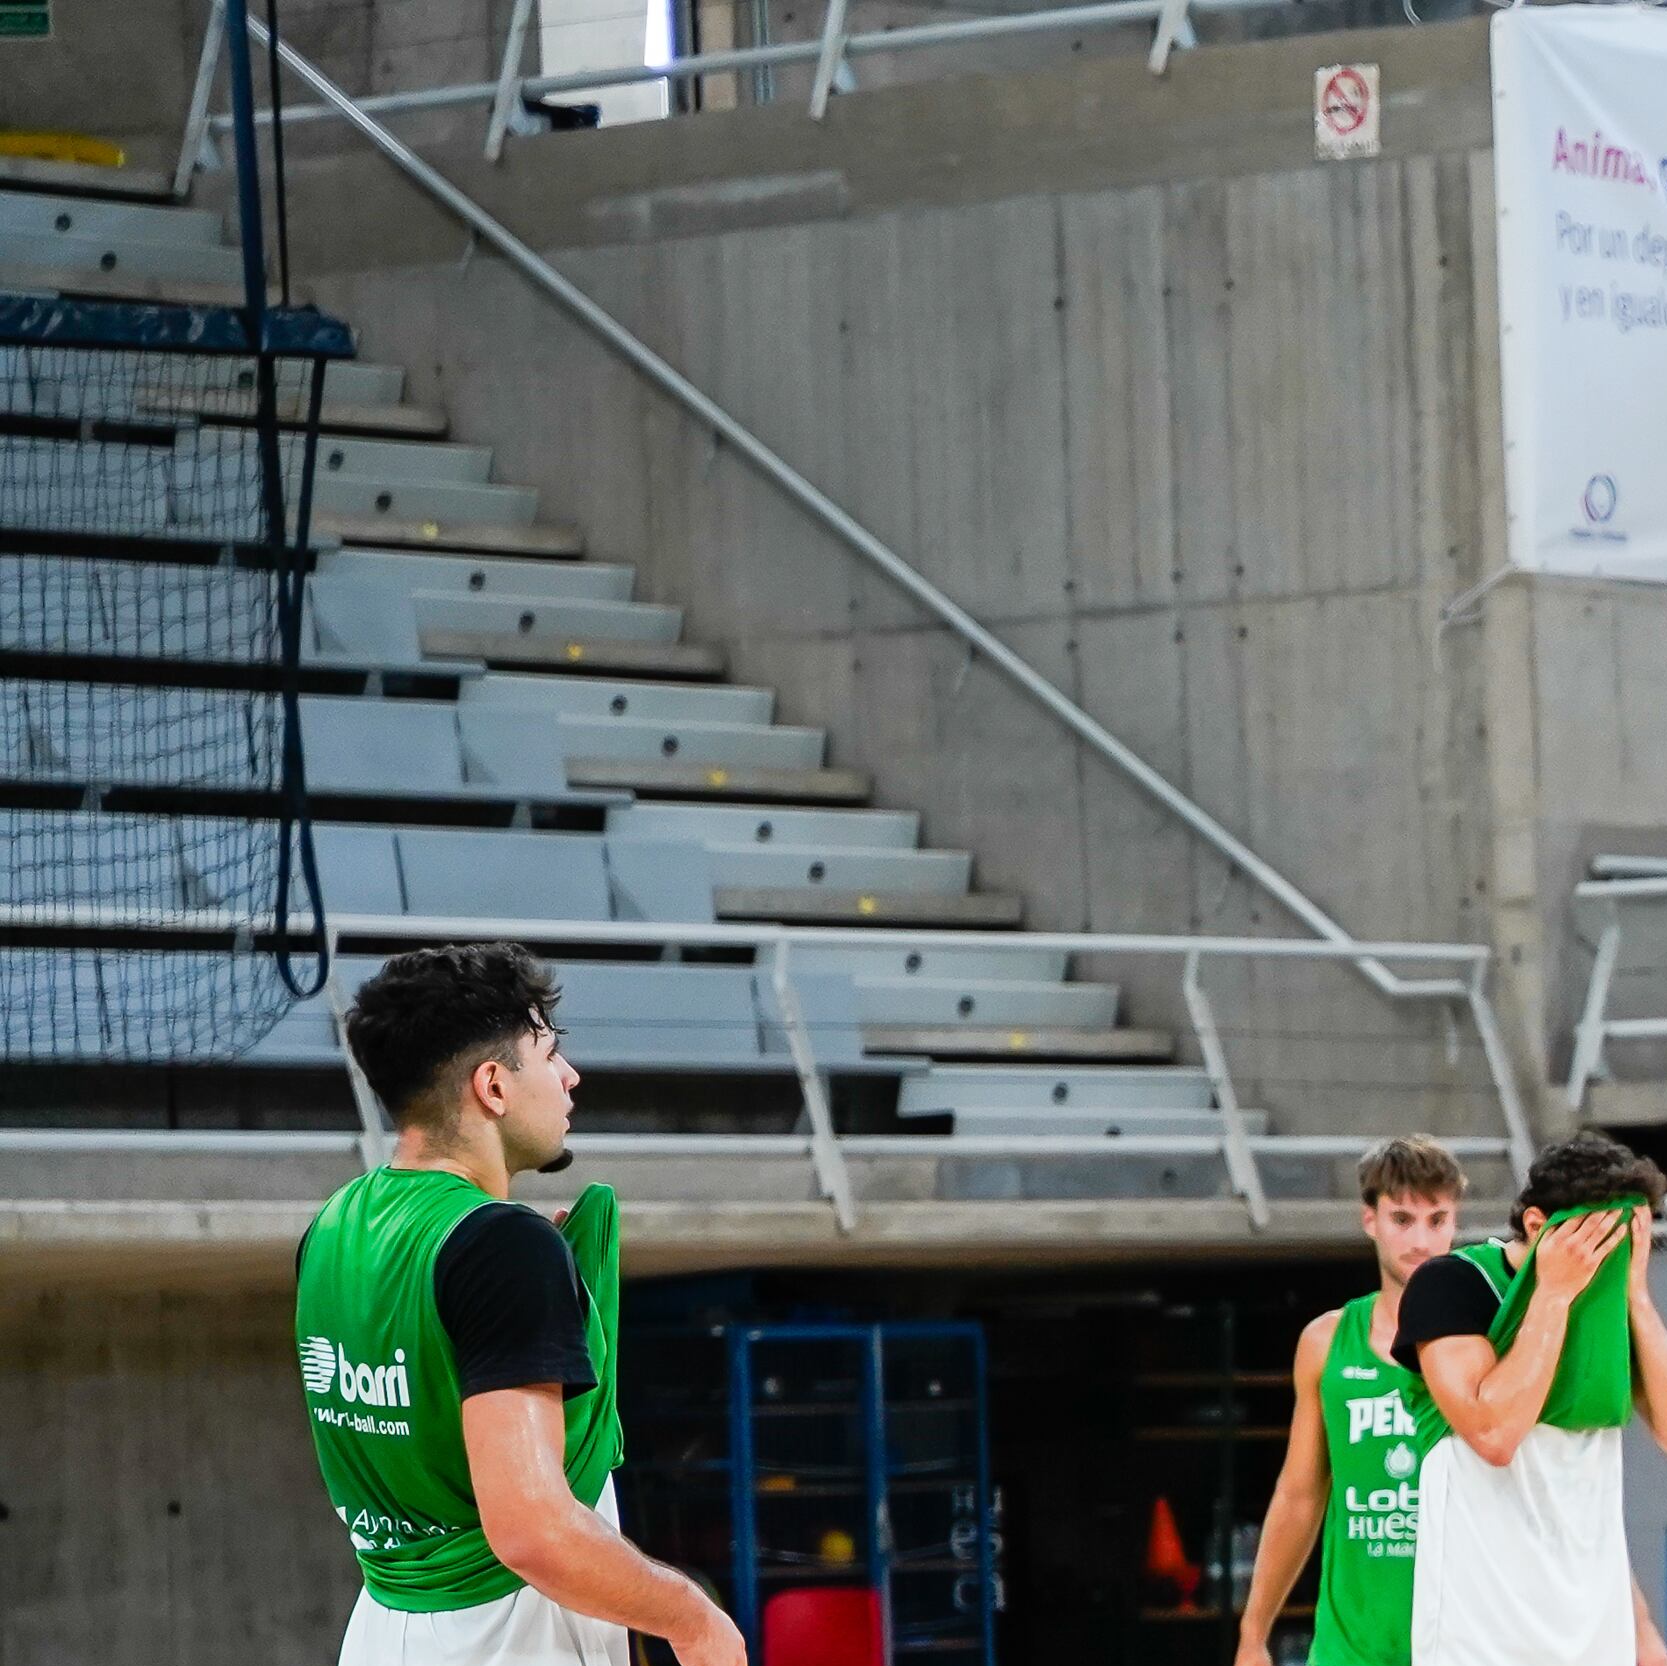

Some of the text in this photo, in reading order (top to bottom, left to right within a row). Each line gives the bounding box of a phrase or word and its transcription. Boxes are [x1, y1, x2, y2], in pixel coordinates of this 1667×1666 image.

[1552, 126, 1660, 192] Anima,
[338, 1342, 411, 1407] barri
[1345, 1388, 1417, 1445] PEÑ
